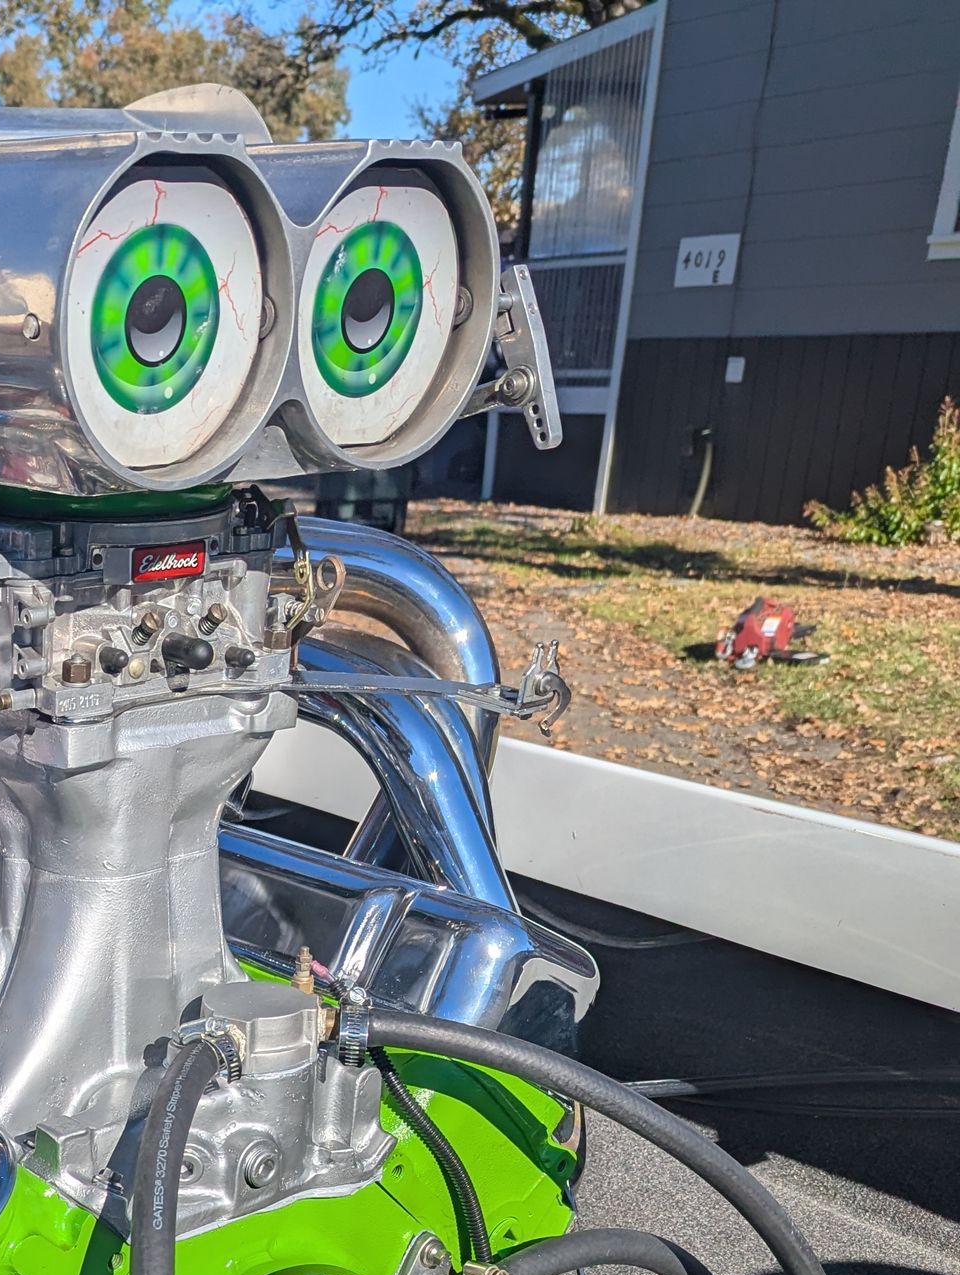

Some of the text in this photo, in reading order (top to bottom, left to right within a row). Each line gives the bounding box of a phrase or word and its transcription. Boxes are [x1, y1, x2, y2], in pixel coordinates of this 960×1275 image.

[683, 249, 726, 270] 4019
[139, 552, 198, 573] Edelbrock
[159, 1112, 176, 1149] Safety
[155, 1149, 168, 1179] 3270
